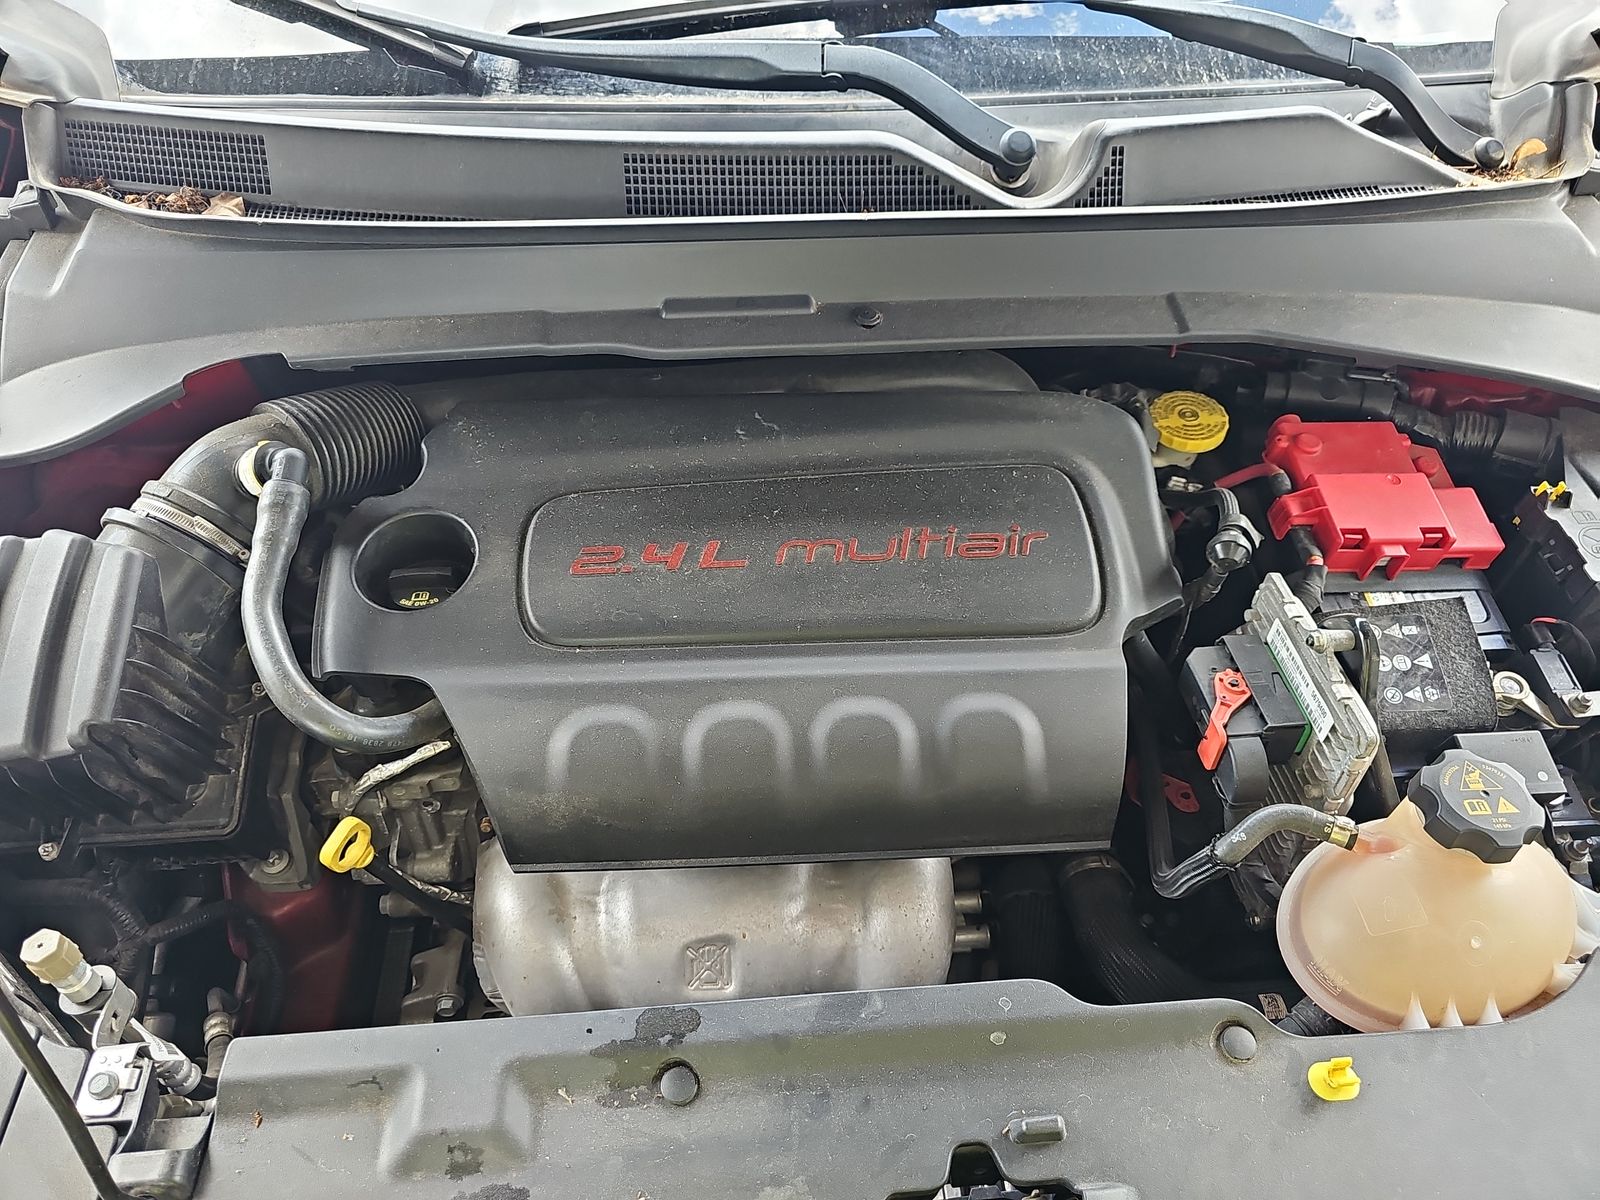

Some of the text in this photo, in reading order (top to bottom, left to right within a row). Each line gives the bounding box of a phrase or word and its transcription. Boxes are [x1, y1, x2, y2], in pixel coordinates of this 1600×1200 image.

[775, 524, 1049, 566] multiair
[399, 597, 440, 607] SAE 0W-20
